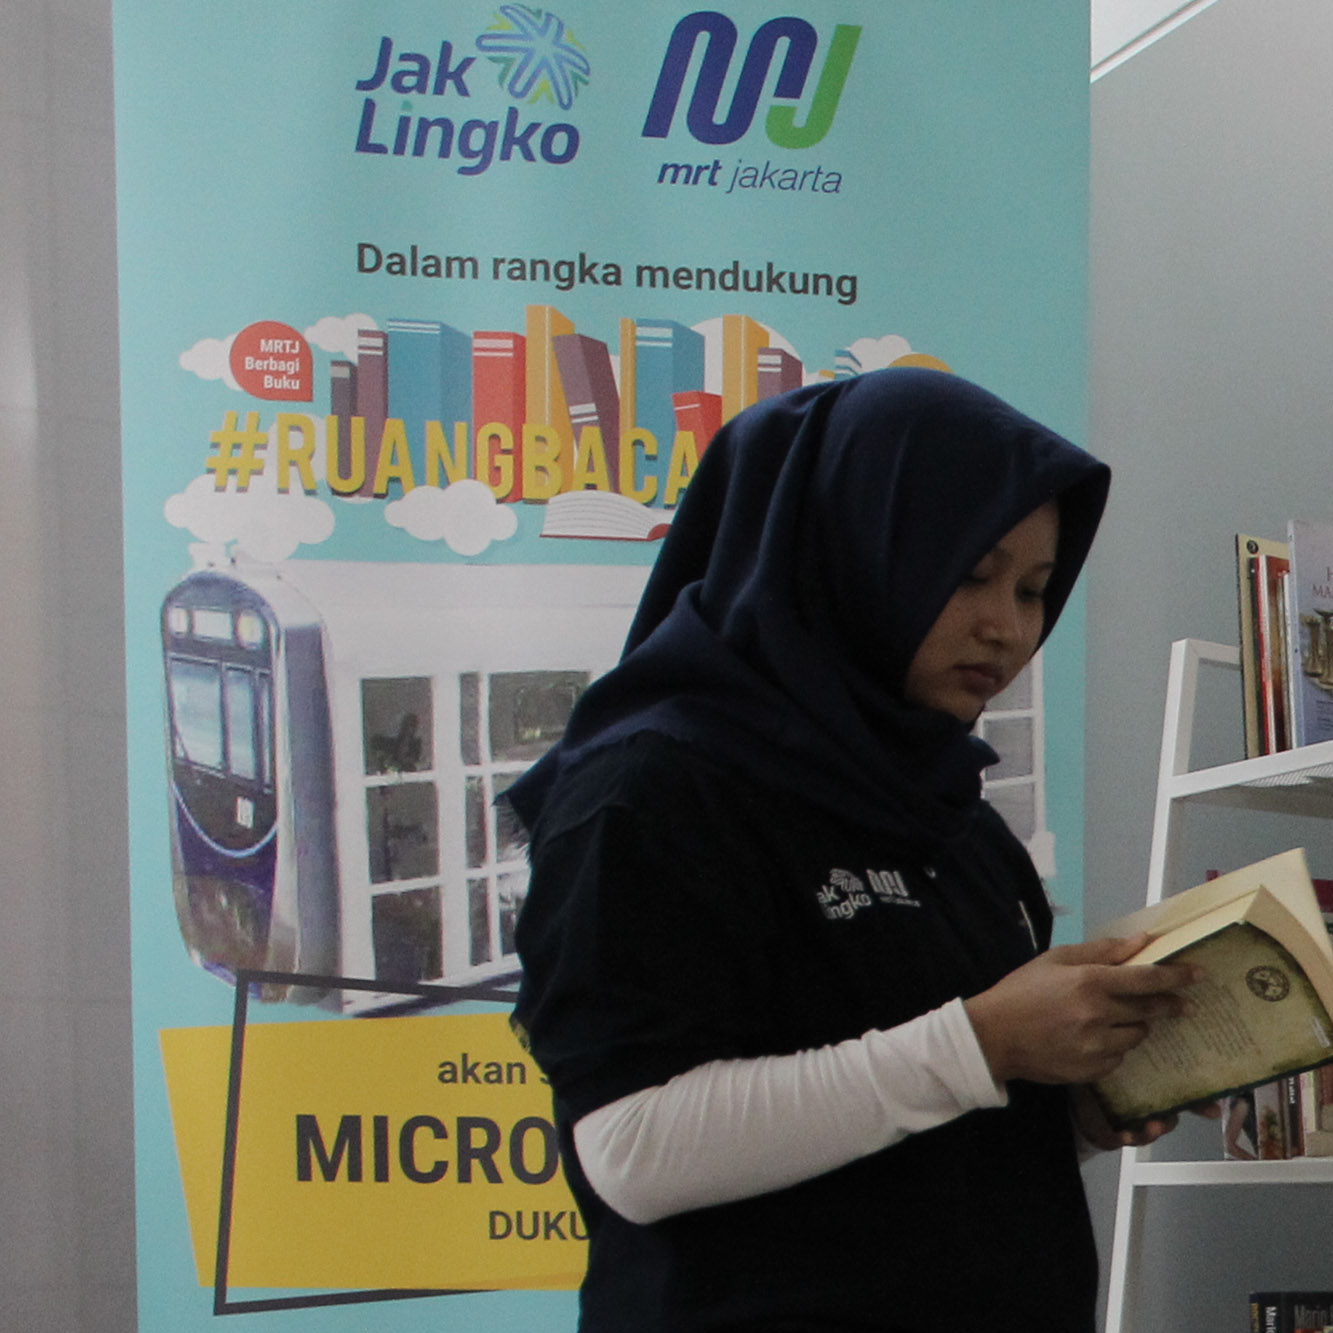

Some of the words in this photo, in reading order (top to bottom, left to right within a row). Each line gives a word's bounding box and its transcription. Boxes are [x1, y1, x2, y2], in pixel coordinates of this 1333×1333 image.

[356, 35, 477, 98] Jak
[355, 99, 580, 174] Lingko
[657, 158, 721, 188] mrt
[726, 159, 842, 196] jakarta
[357, 243, 480, 281] Dalam
[492, 248, 622, 290] rangka
[636, 261, 859, 305] mendukung
[259, 338, 301, 355] MRTJ
[244, 356, 302, 376] Berbagi
[263, 373, 301, 391] Buku
[437, 1053, 527, 1085] akan
[295, 1114, 562, 1185] MICRO
